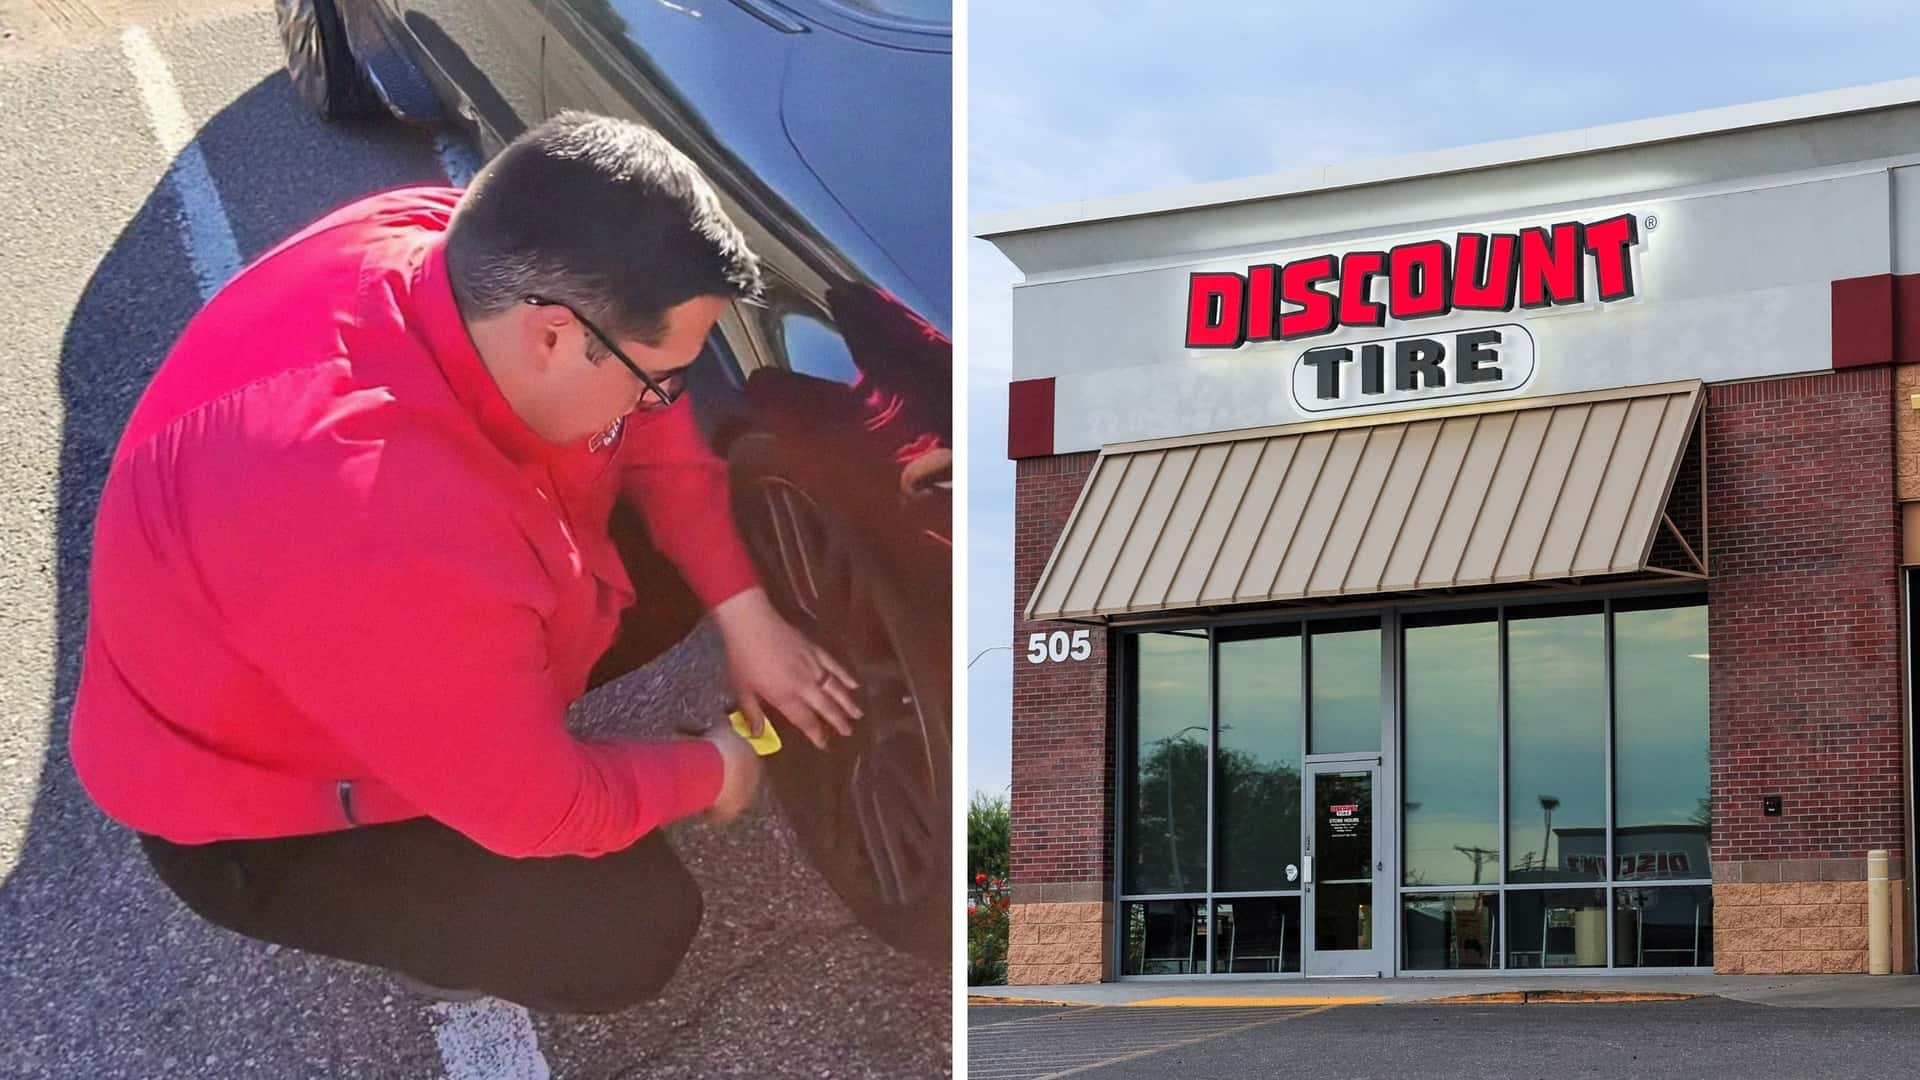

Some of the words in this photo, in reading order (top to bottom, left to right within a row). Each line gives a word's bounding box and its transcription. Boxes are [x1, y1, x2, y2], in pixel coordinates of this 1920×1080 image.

[1186, 214, 1637, 349] DISCOUNT
[1304, 330, 1503, 400] TIRE
[1027, 630, 1092, 663] 505
